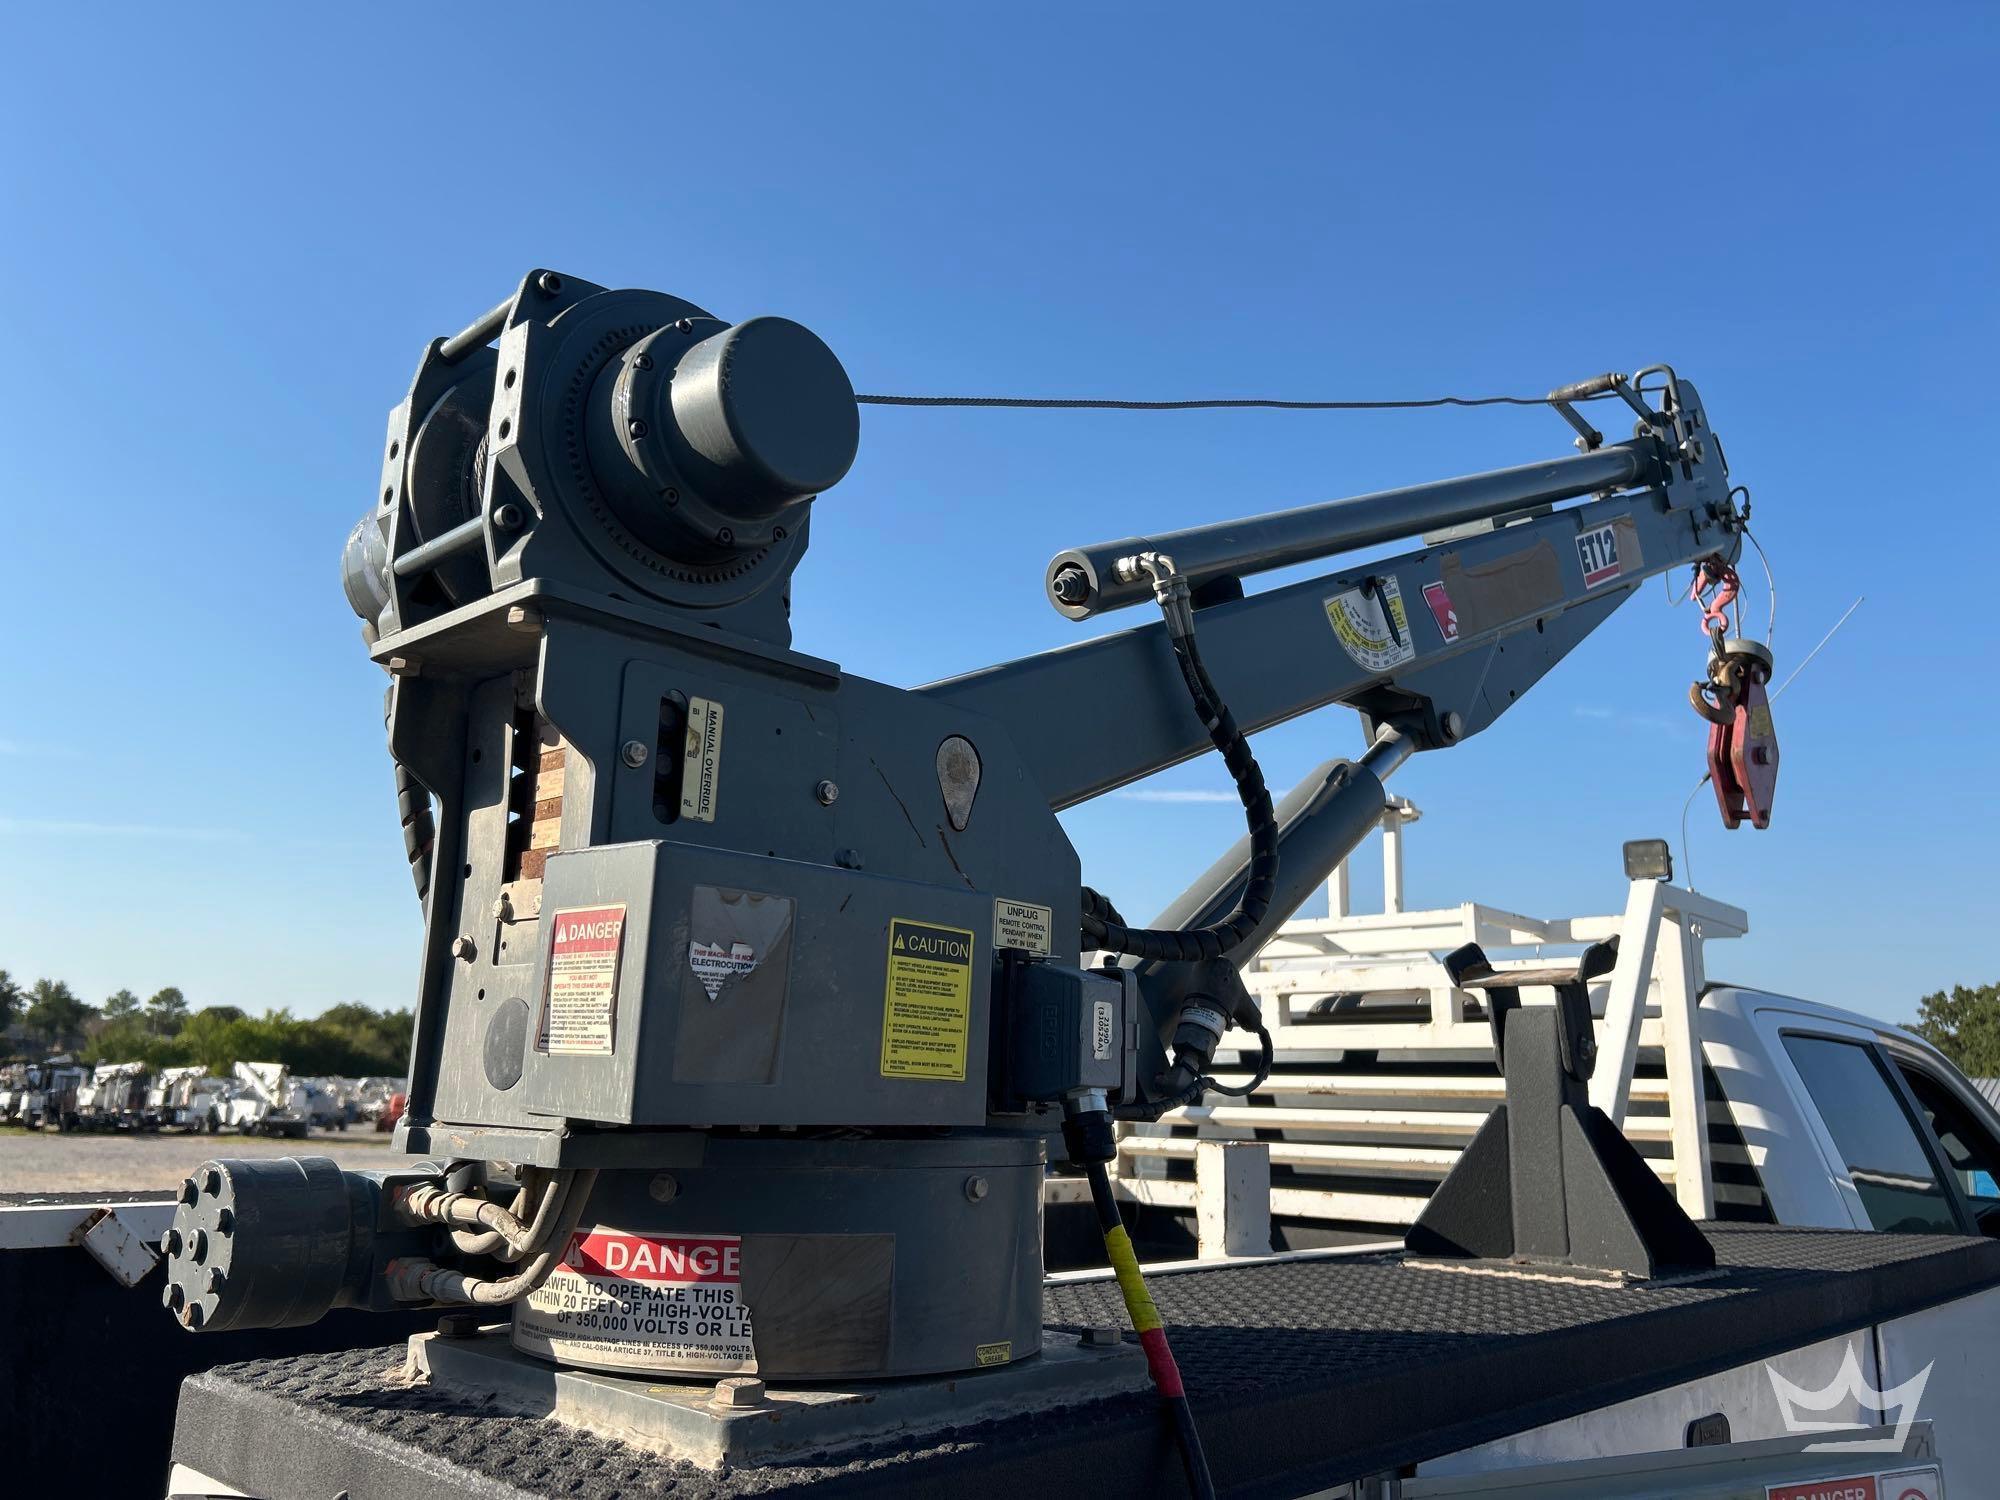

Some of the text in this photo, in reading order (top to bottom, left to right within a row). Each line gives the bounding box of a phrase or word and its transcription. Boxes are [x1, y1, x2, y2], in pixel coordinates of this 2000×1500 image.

[1577, 529, 1617, 574] ET12
[701, 710, 718, 814] MANUAL OVERRIDE
[683, 799, 693, 808] RL
[1008, 906, 1038, 920] UNPLUG
[570, 920, 622, 941] DANGER
[999, 918, 1046, 932] REMOTE CONTROL
[1002, 928, 1043, 940] PENDANT WHEN
[909, 936, 969, 958] CAUTION
[1026, 940, 1038, 949] USE
[692, 958, 753, 970] ELECTROCUTION
[1097, 1006, 1105, 1052] (310524A)
[586, 1280, 603, 1296] TO
[608, 1284, 686, 1302] OPERATE
[692, 1288, 734, 1304] THIS
[564, 1295, 577, 1309] 20
[580, 1296, 617, 1314] FEET
[620, 1301, 642, 1316] OF
[558, 1310, 752, 1337] OF 350,000 VOLTS OR LE
[582, 1342, 612, 1352] CAL-OSHA
[686, 1352, 743, 1360] HIGH-VOLTAGE
